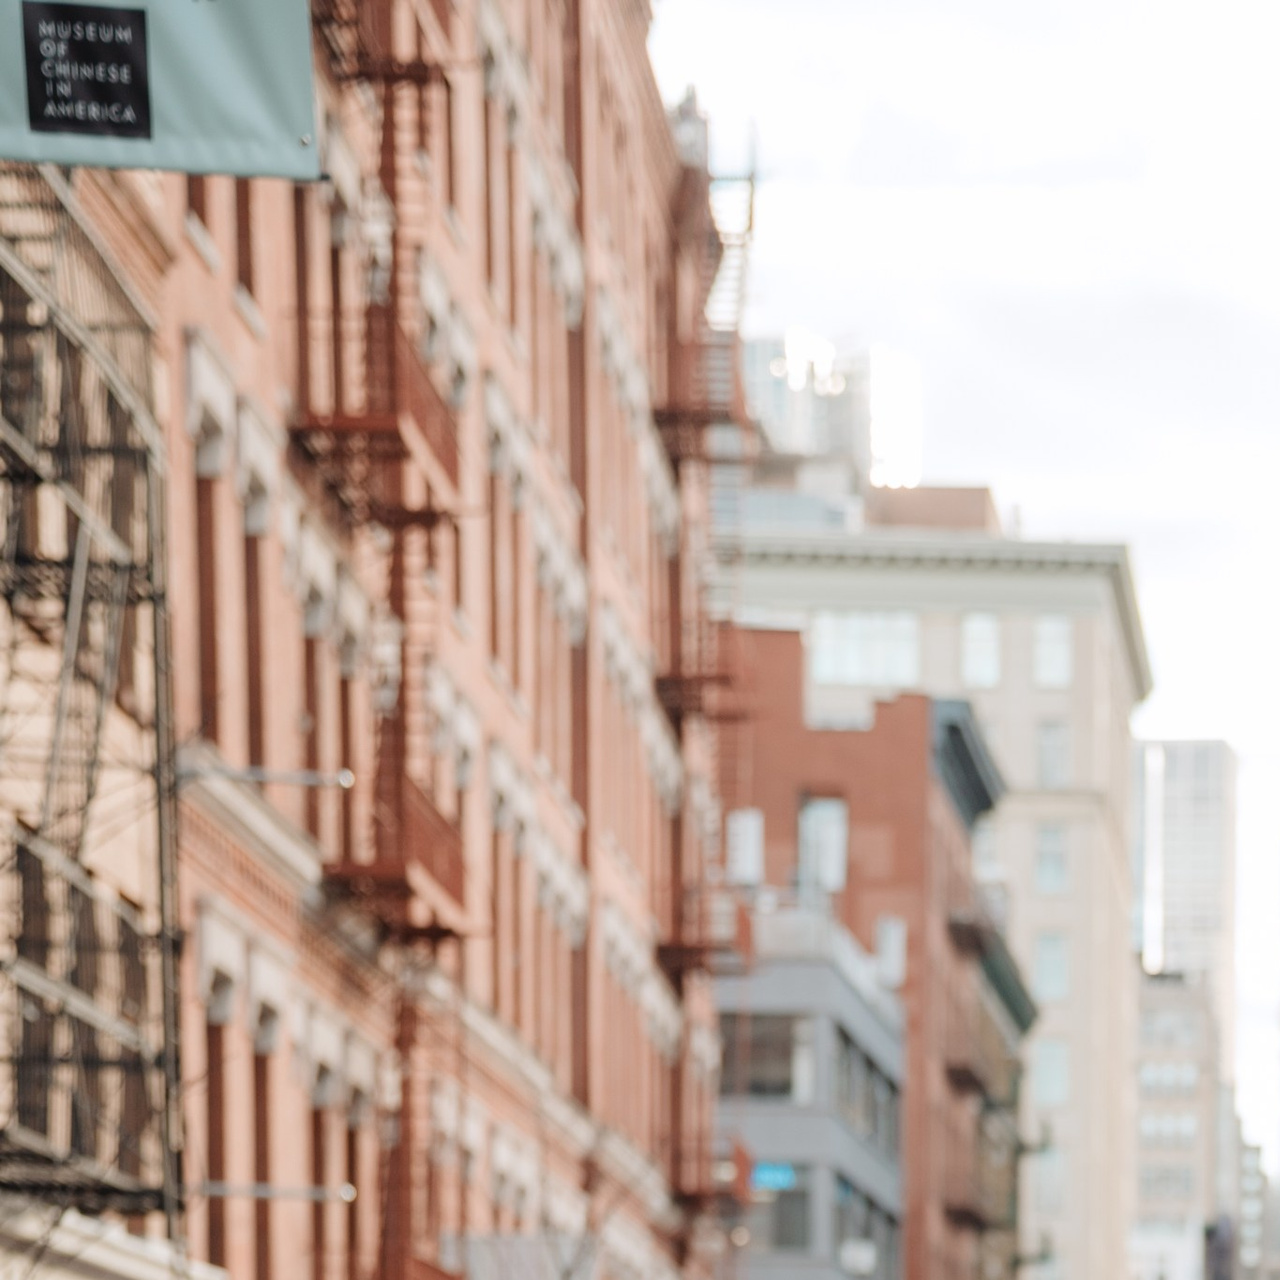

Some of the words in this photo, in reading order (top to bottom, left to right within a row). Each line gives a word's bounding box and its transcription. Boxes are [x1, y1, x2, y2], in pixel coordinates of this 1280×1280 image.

[38, 20, 132, 44] MUSEUM
[39, 39, 68, 58] OF
[40, 60, 132, 84] CHINESE
[45, 79, 72, 99] IN
[43, 100, 136, 123] AMERICA
